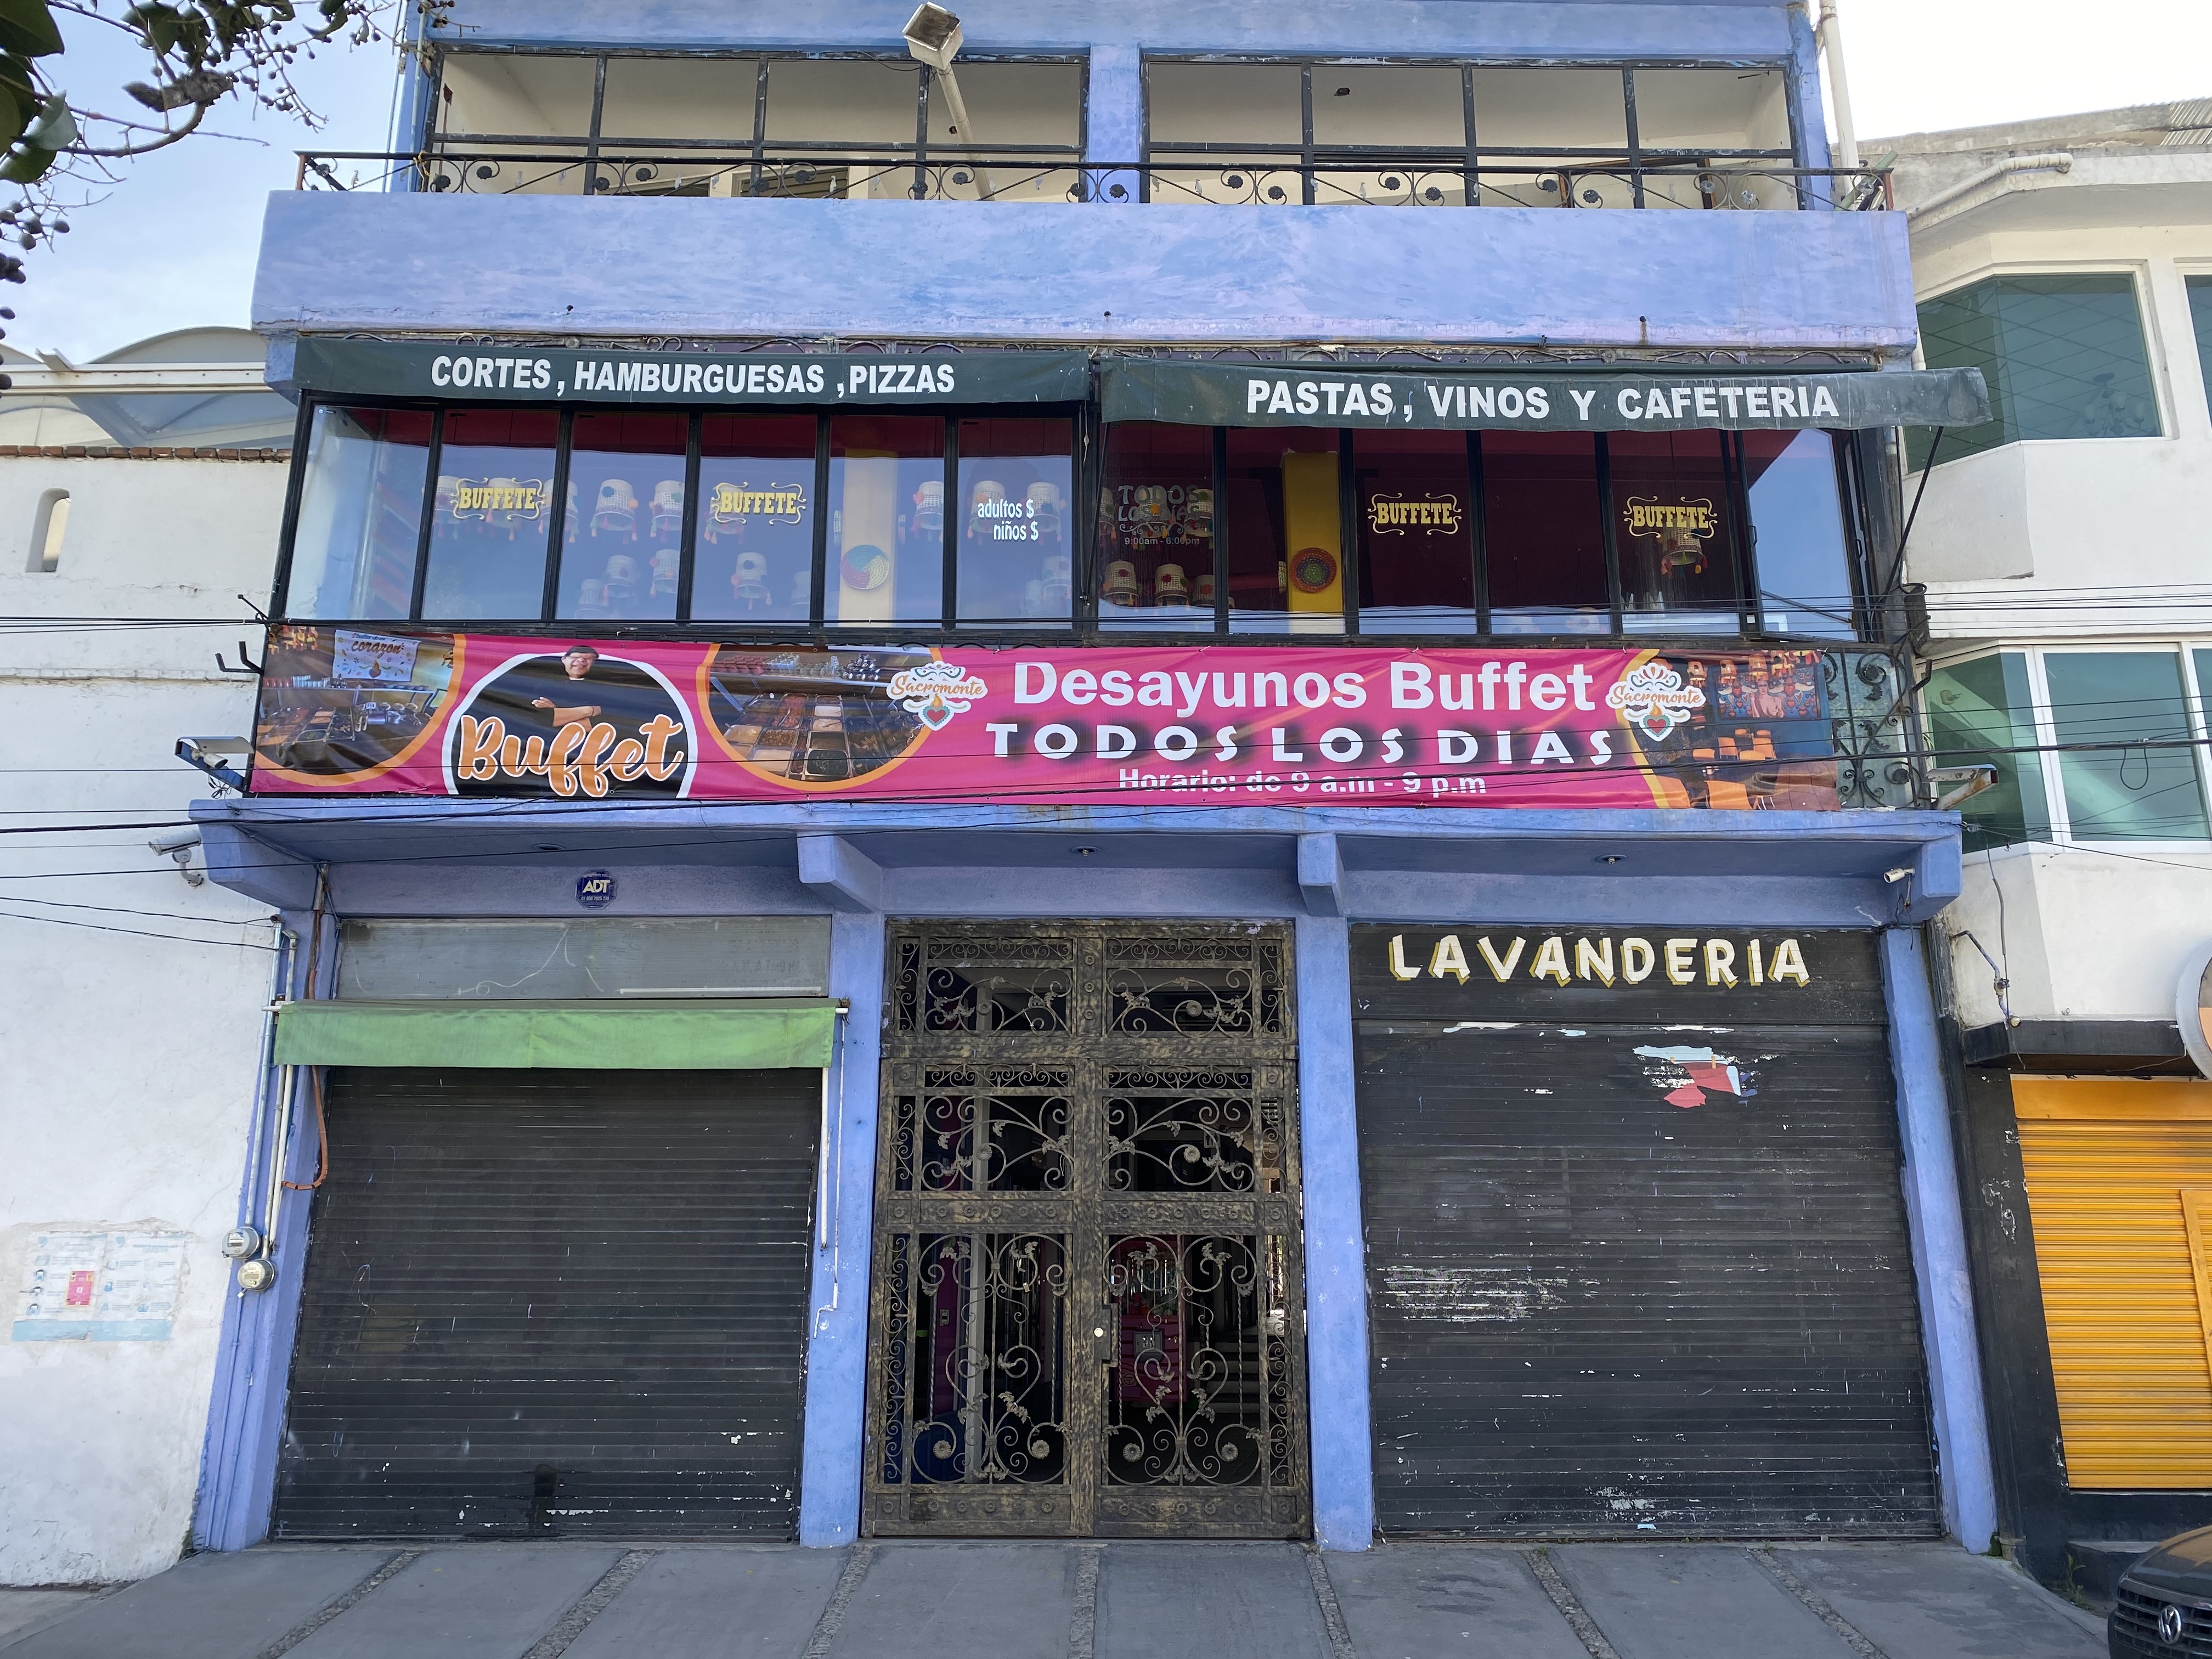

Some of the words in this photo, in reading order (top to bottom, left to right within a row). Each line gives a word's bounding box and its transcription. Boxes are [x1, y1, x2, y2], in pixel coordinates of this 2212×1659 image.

[574, 361, 824, 393] HAMBURGUESAS
[1427, 385, 1550, 419] VINOS
[1569, 390, 1596, 421] Y
[1617, 386, 1839, 419] CAFETERIA
[459, 487, 537, 509] BUFFETE
[720, 492, 797, 514] BUFFETE
[1118, 485, 1200, 504] TODOS
[977, 499, 1023, 518] adultos
[1026, 498, 1035, 519] $
[1118, 506, 1152, 522] LOS
[1376, 503, 1453, 524] BUFFETE
[1632, 505, 1709, 528] BUFFETE
[994, 520, 1027, 540] niños
[1030, 520, 1039, 541] $
[1124, 537, 1158, 545] 9:00am
[1165, 537, 1200, 547] 6:00pm
[891, 675, 984, 696] Sacromonte
[1014, 662, 1367, 718] Desayunos
[1390, 662, 1596, 710] Buffet
[1610, 685, 1702, 704] Sacromonte
[985, 723, 1238, 762] TODOS
[1272, 727, 1404, 764] LOS
[1437, 730, 1612, 765] DIAS
[458, 714, 684, 797] Buffet
[1119, 769, 1235, 792] Horario:
[1291, 771, 1310, 792] 9
[1402, 771, 1421, 793] 9
[582, 879, 610, 893] ADT
[1389, 934, 1812, 989] LAVANDERIA
